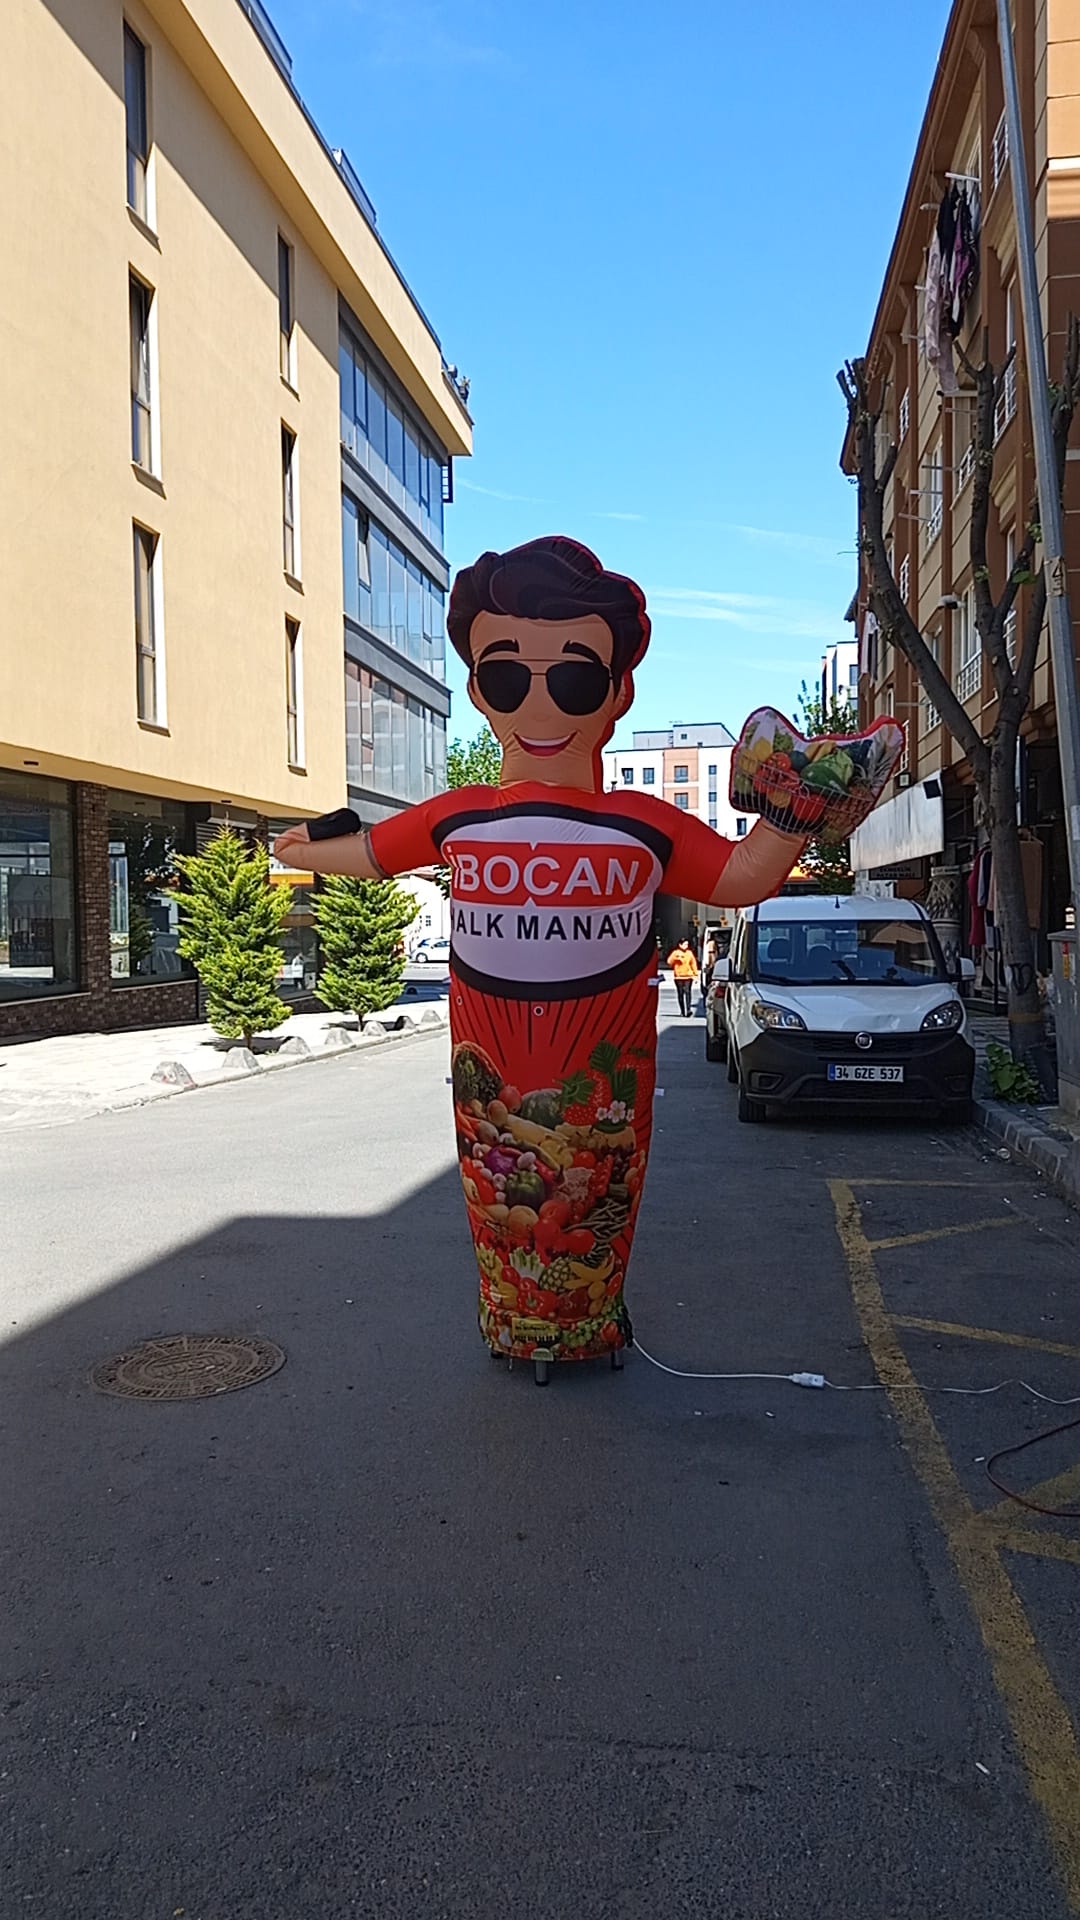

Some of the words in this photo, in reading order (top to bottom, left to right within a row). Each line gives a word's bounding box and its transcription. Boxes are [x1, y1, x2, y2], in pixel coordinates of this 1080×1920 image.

[516, 911, 642, 941] MANAVI
[836, 1067, 849, 1079] 34
[854, 1067, 875, 1080] GZE
[880, 1068, 900, 1080] 537
